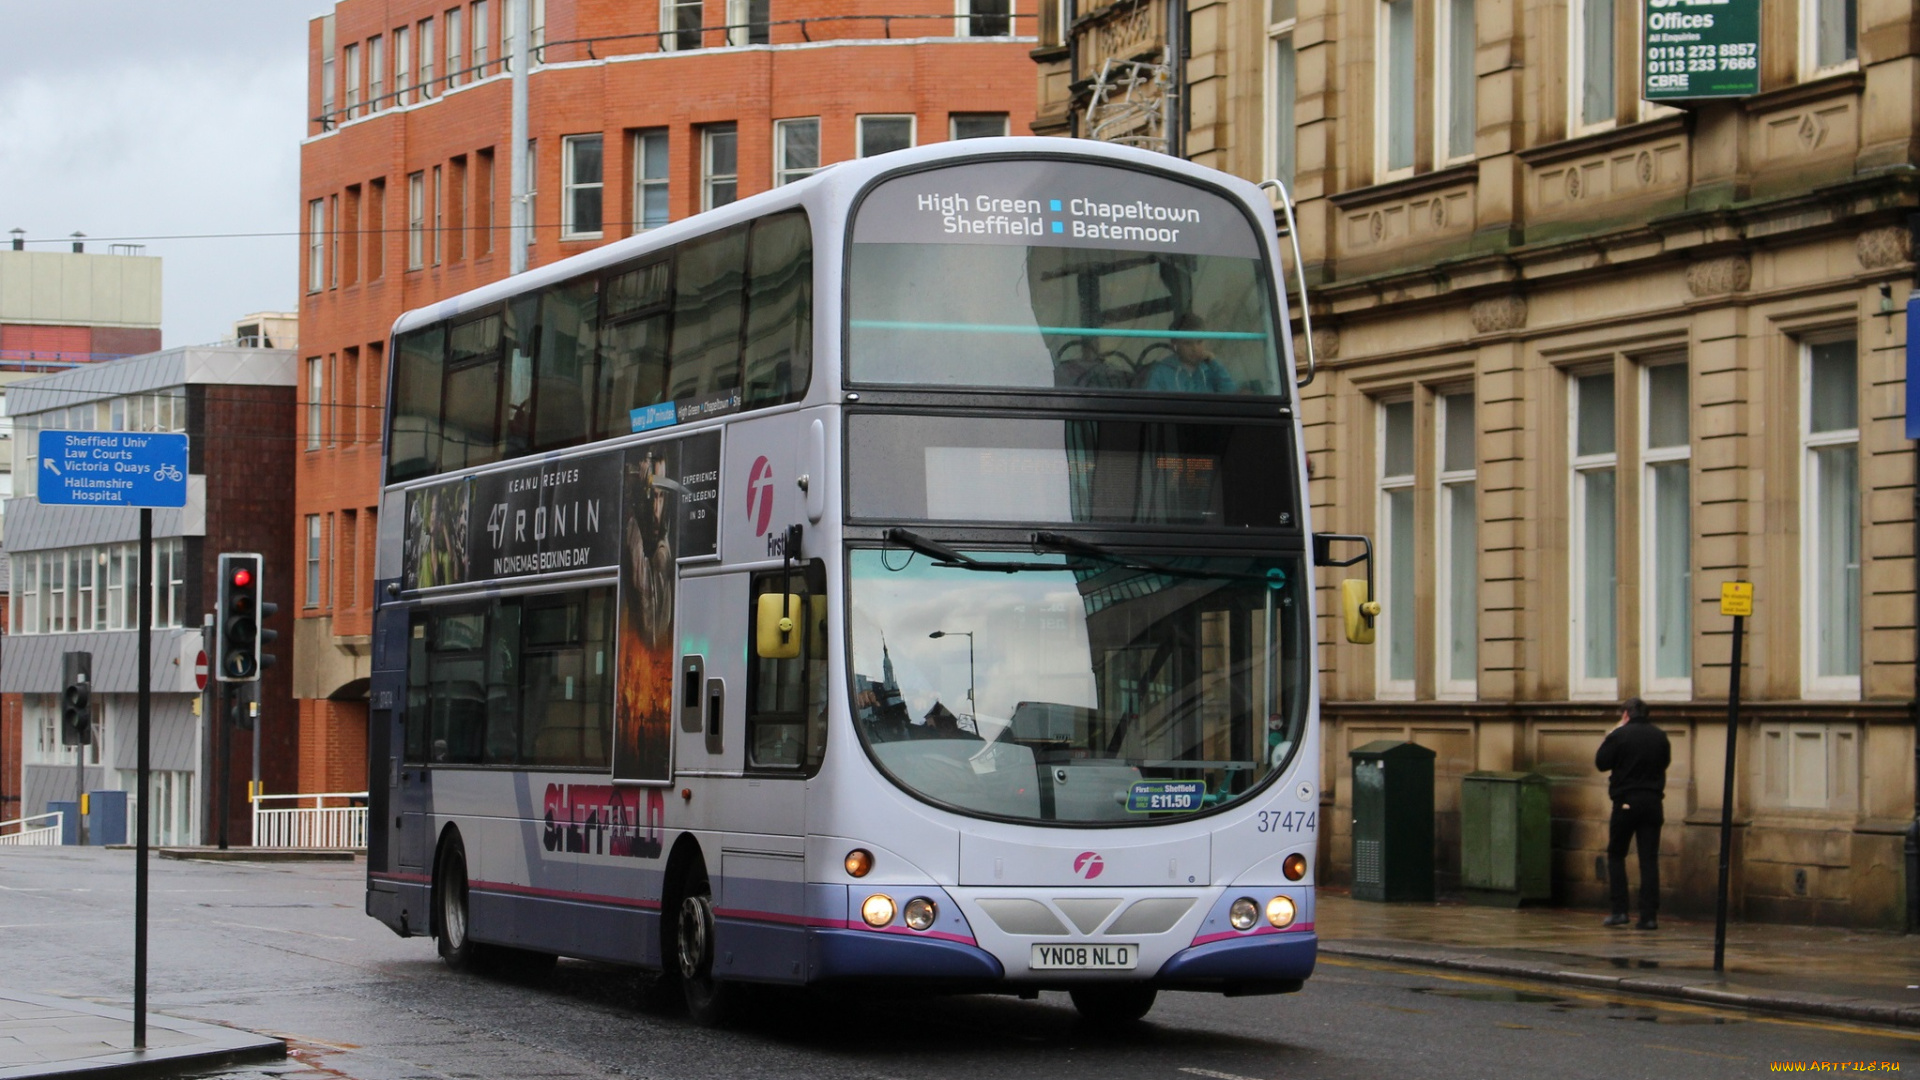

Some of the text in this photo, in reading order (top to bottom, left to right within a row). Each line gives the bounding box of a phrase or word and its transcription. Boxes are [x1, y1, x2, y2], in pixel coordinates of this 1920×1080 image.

[1649, 12, 1714, 30] Offices
[1649, 32, 1701, 43] All Enquiries
[1648, 43, 1757, 60] 0114 273 8857
[1648, 58, 1757, 73] 0113 233 7666
[1648, 74, 1690, 87] CBRE
[918, 193, 1041, 216] High Green
[1070, 198, 1200, 223] Chapeltown
[943, 214, 1044, 236] Sheffield
[1073, 220, 1180, 243] Batemoor
[678, 404, 700, 420] High Green
[704, 398, 729, 414] Chapeltown
[632, 415, 646, 429] every
[656, 408, 675, 422] minutes
[65, 435, 117, 448] Sheffield
[65, 448, 133, 460] Law Courts
[64, 461, 150, 475] Victoria Quays
[64, 477, 133, 490] Hallamshire
[509, 469, 579, 493] KEANU REEVES
[683, 470, 717, 485] EXPERIENCE
[72, 489, 122, 502] Hospital
[682, 489, 717, 504] THE LEGEND
[690, 509, 706, 521] IN 3D
[487, 499, 600, 549] 47 RONIN
[768, 532, 786, 557] First
[494, 547, 590, 575] IN CINEMAS BOXING DAY
[1165, 784, 1196, 793] Sheffield
[1151, 794, 1191, 808] £11.50
[543, 783, 664, 859] SHEFFIELD
[1257, 810, 1316, 832] 37474
[1040, 947, 1128, 965] YN08 NLO
